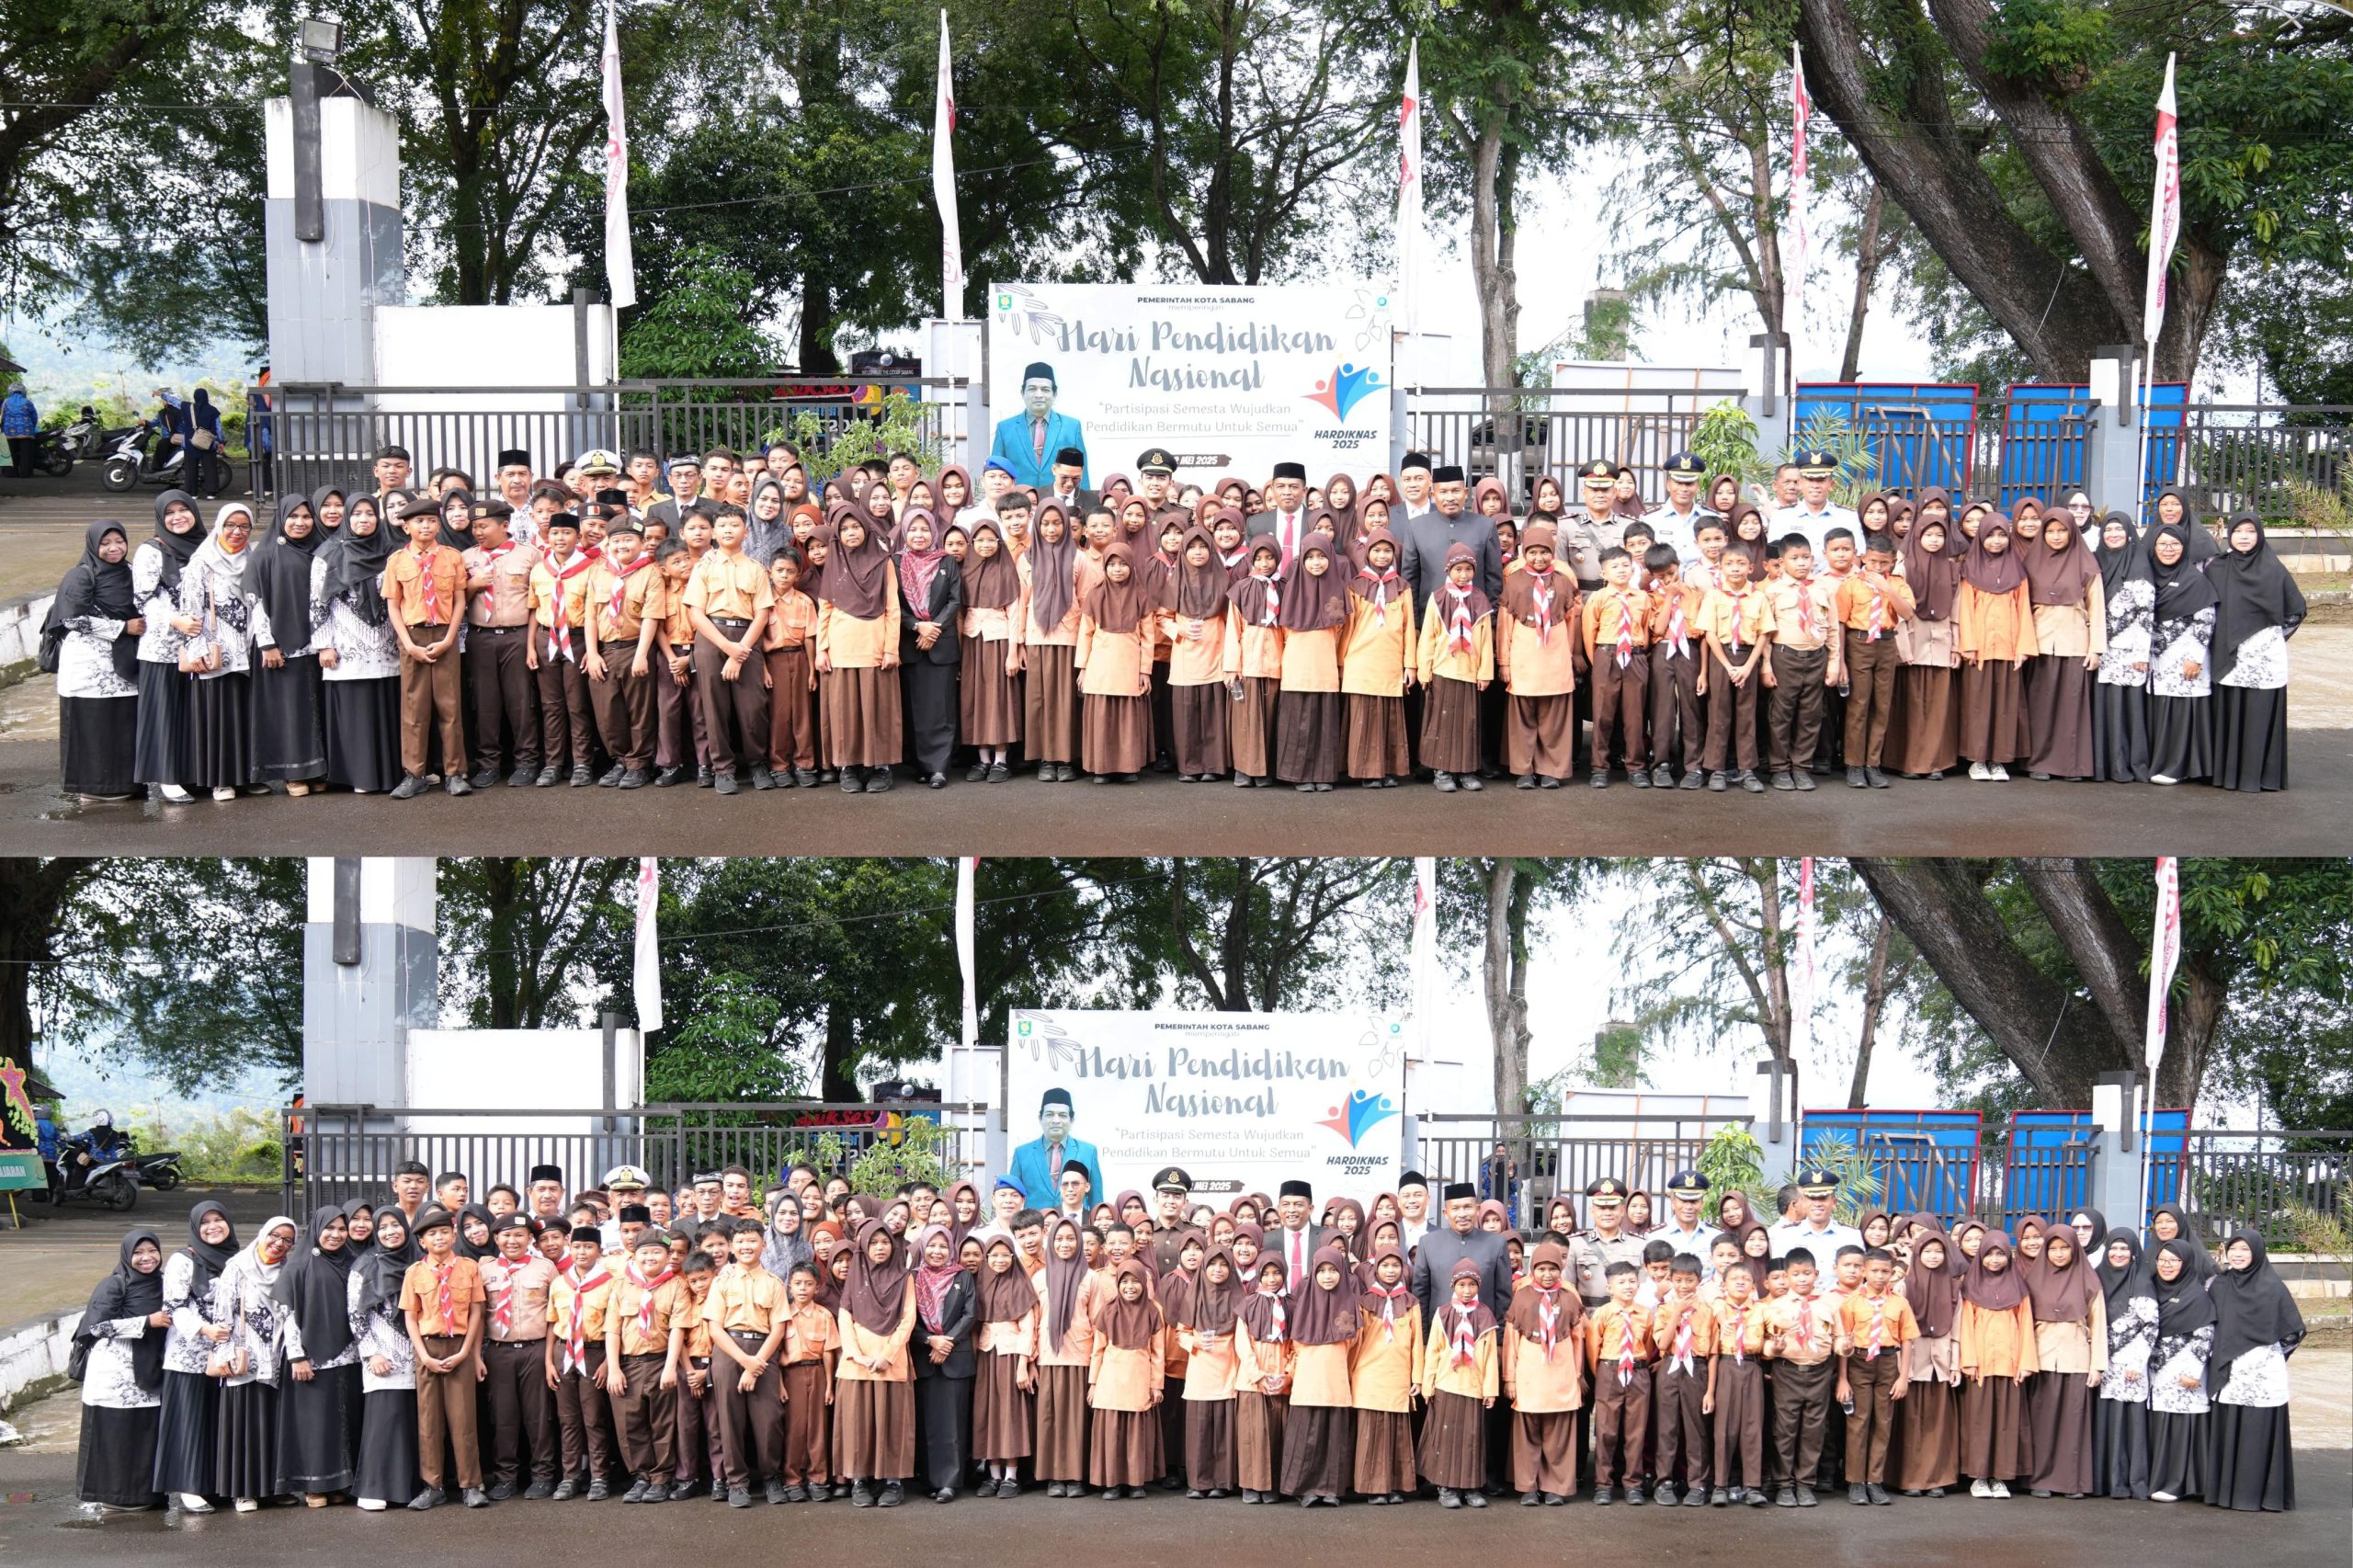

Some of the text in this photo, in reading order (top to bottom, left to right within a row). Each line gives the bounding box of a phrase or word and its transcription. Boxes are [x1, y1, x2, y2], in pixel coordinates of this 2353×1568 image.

[1057, 320, 1337, 355] Hari Pendidikan
[1129, 356, 1265, 392] Nasional
[1173, 403, 1226, 415] Semesta
[1230, 403, 1291, 416] Wujudkan
[1086, 421, 1154, 433] Pendidikan
[1157, 421, 1211, 433] Bermutu
[1215, 421, 1253, 433] Untuk
[1313, 429, 1378, 440] HARDIKNAS
[1332, 440, 1359, 449] 2025
[1180, 456, 1195, 465] MEI
[1196, 456, 1219, 465] 2025
[1185, 1029, 1240, 1038] memperingati
[1074, 1046, 1350, 1081] Hari Pendidikan
[1144, 1082, 1279, 1118] Nasional
[1188, 1129, 1240, 1140] Semesta
[1244, 1129, 1304, 1142] Wujudkan
[1102, 1146, 1168, 1158] Pendidikan
[1172, 1146, 1225, 1158] Bermutu
[1229, 1146, 1267, 1158] Untuk
[1325, 1155, 1389, 1165] HARDIKNAS
[1343, 1165, 1371, 1176] 2025
[1194, 1182, 1209, 1191] MEI
[1210, 1182, 1232, 1191] 2025
